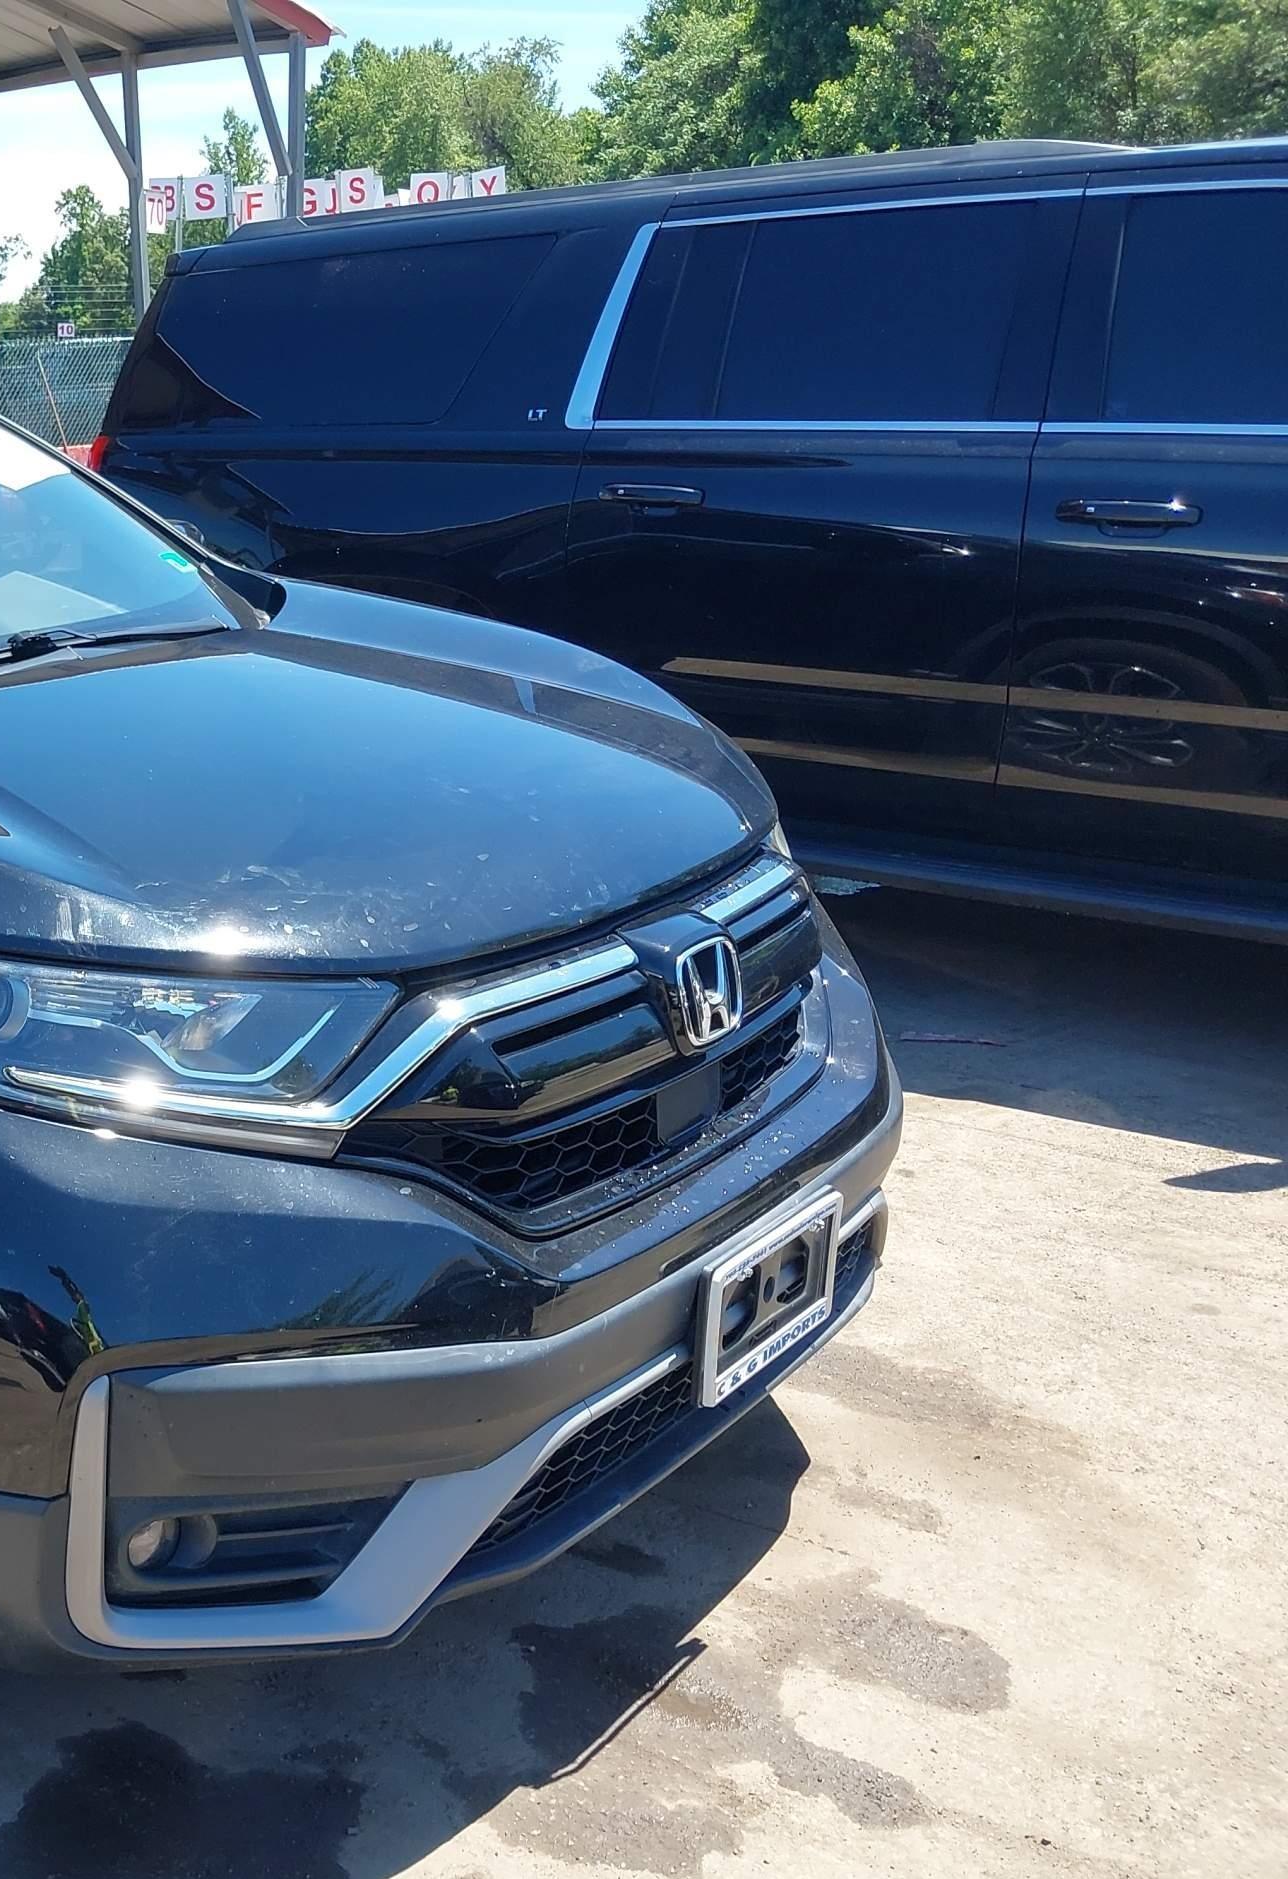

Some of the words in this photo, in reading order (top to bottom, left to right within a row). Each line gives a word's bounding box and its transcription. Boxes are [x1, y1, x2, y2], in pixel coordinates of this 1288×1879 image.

[195, 183, 216, 211] S
[325, 187, 337, 214] J
[349, 177, 366, 204] S
[147, 198, 164, 225] 70
[247, 193, 263, 220] F
[59, 325, 74, 335] 10
[527, 409, 548, 421] LT
[717, 1383, 727, 1397] C
[730, 1372, 742, 1387] &
[747, 1357, 759, 1371] G
[762, 1306, 827, 1363] IMPORTS
